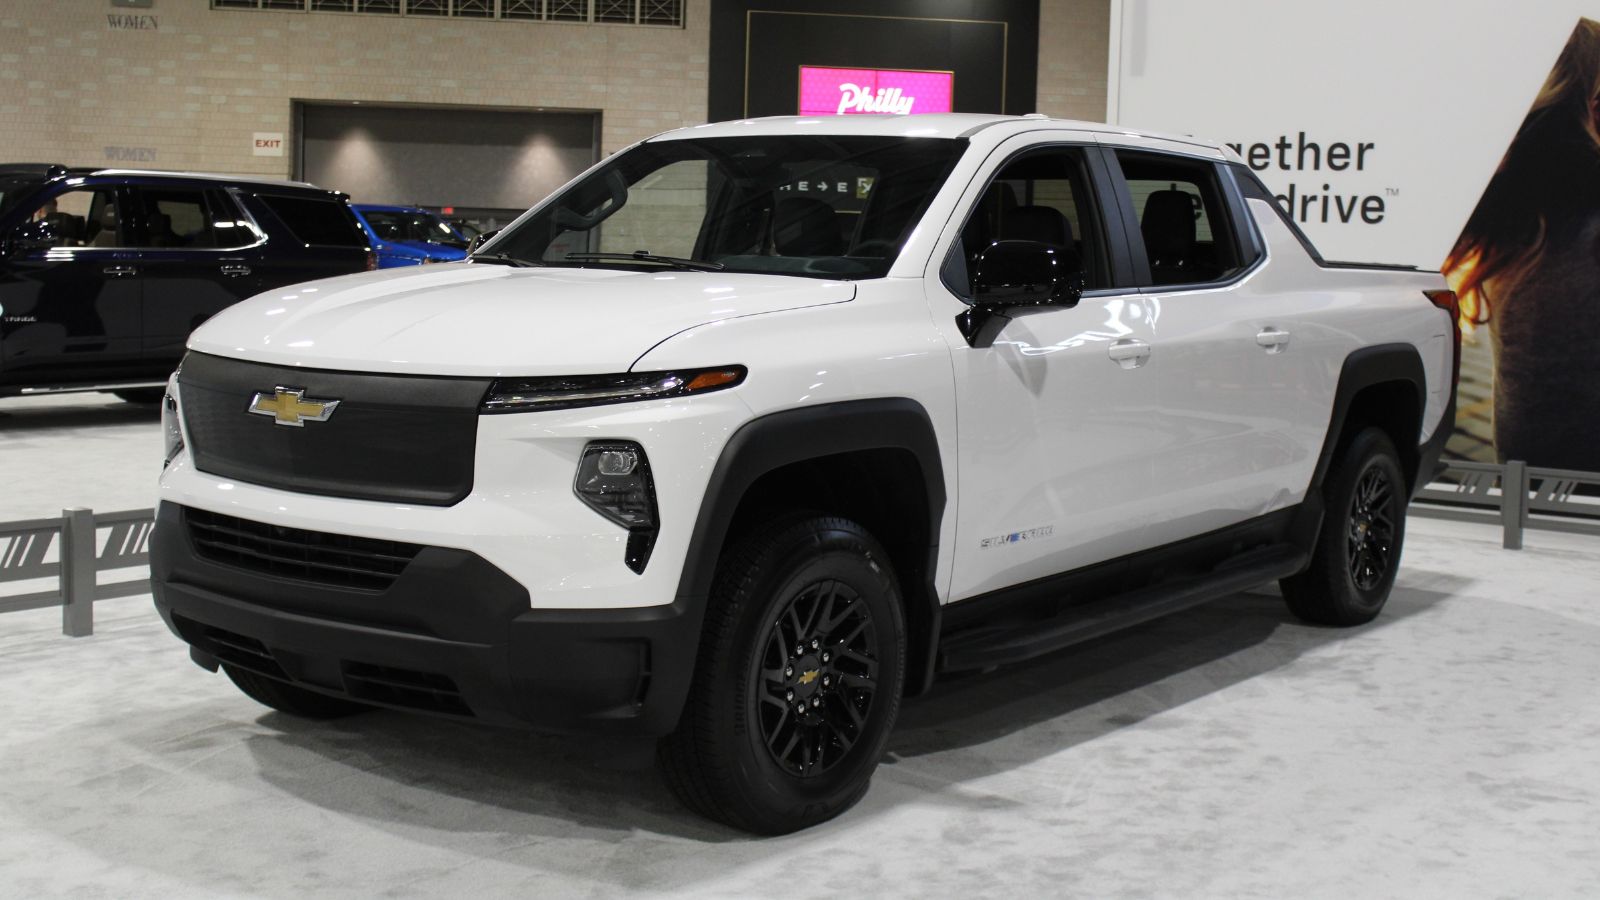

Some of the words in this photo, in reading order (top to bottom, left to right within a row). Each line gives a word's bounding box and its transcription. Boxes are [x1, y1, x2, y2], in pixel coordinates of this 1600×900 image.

[106, 14, 159, 30] WOMEN
[836, 83, 915, 115] Philly
[103, 146, 158, 161] WOMEN
[255, 139, 281, 148] EXIT
[1225, 131, 1375, 171] ether
[1275, 183, 1386, 224] drive
